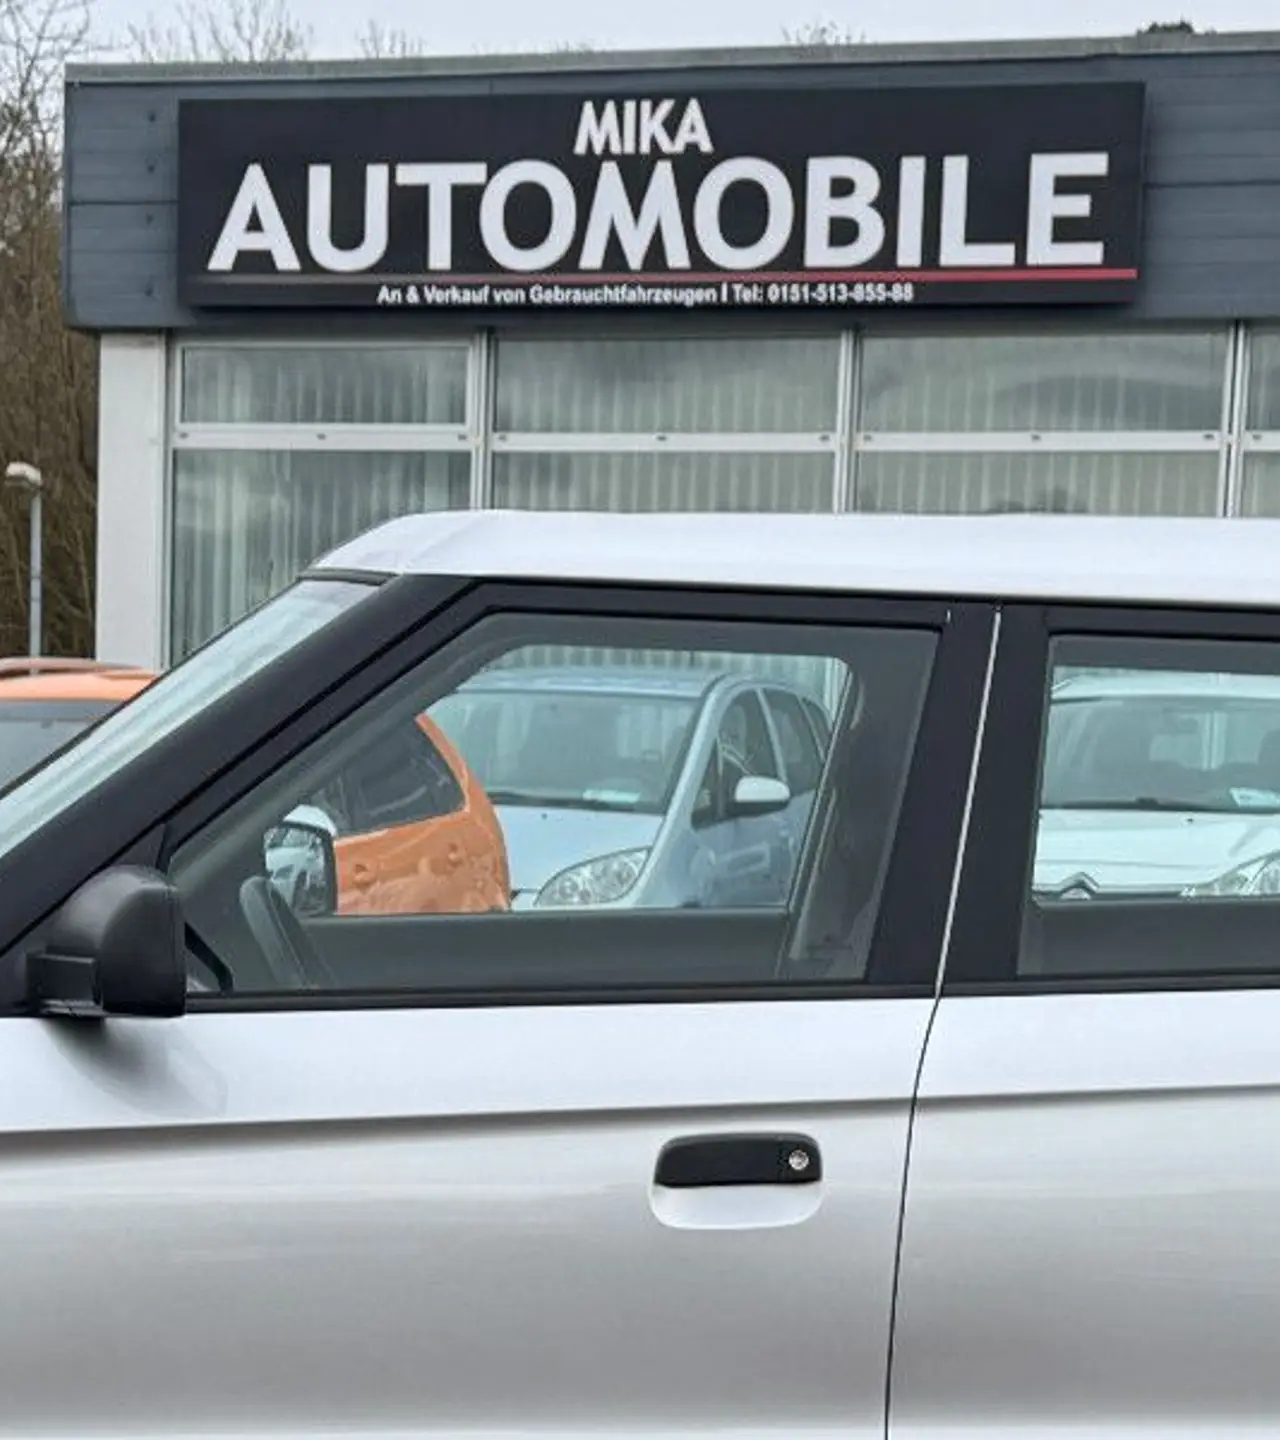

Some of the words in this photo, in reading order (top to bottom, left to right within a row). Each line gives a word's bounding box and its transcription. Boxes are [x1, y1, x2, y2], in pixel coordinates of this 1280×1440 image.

[574, 99, 713, 155] MIKA
[206, 152, 1110, 272] AUTOMOBILE
[377, 286, 402, 304] An
[406, 286, 419, 303] &
[423, 285, 490, 303] Verkauf
[493, 289, 526, 303] von
[529, 284, 718, 307] Gebrauchtfahrzeugen
